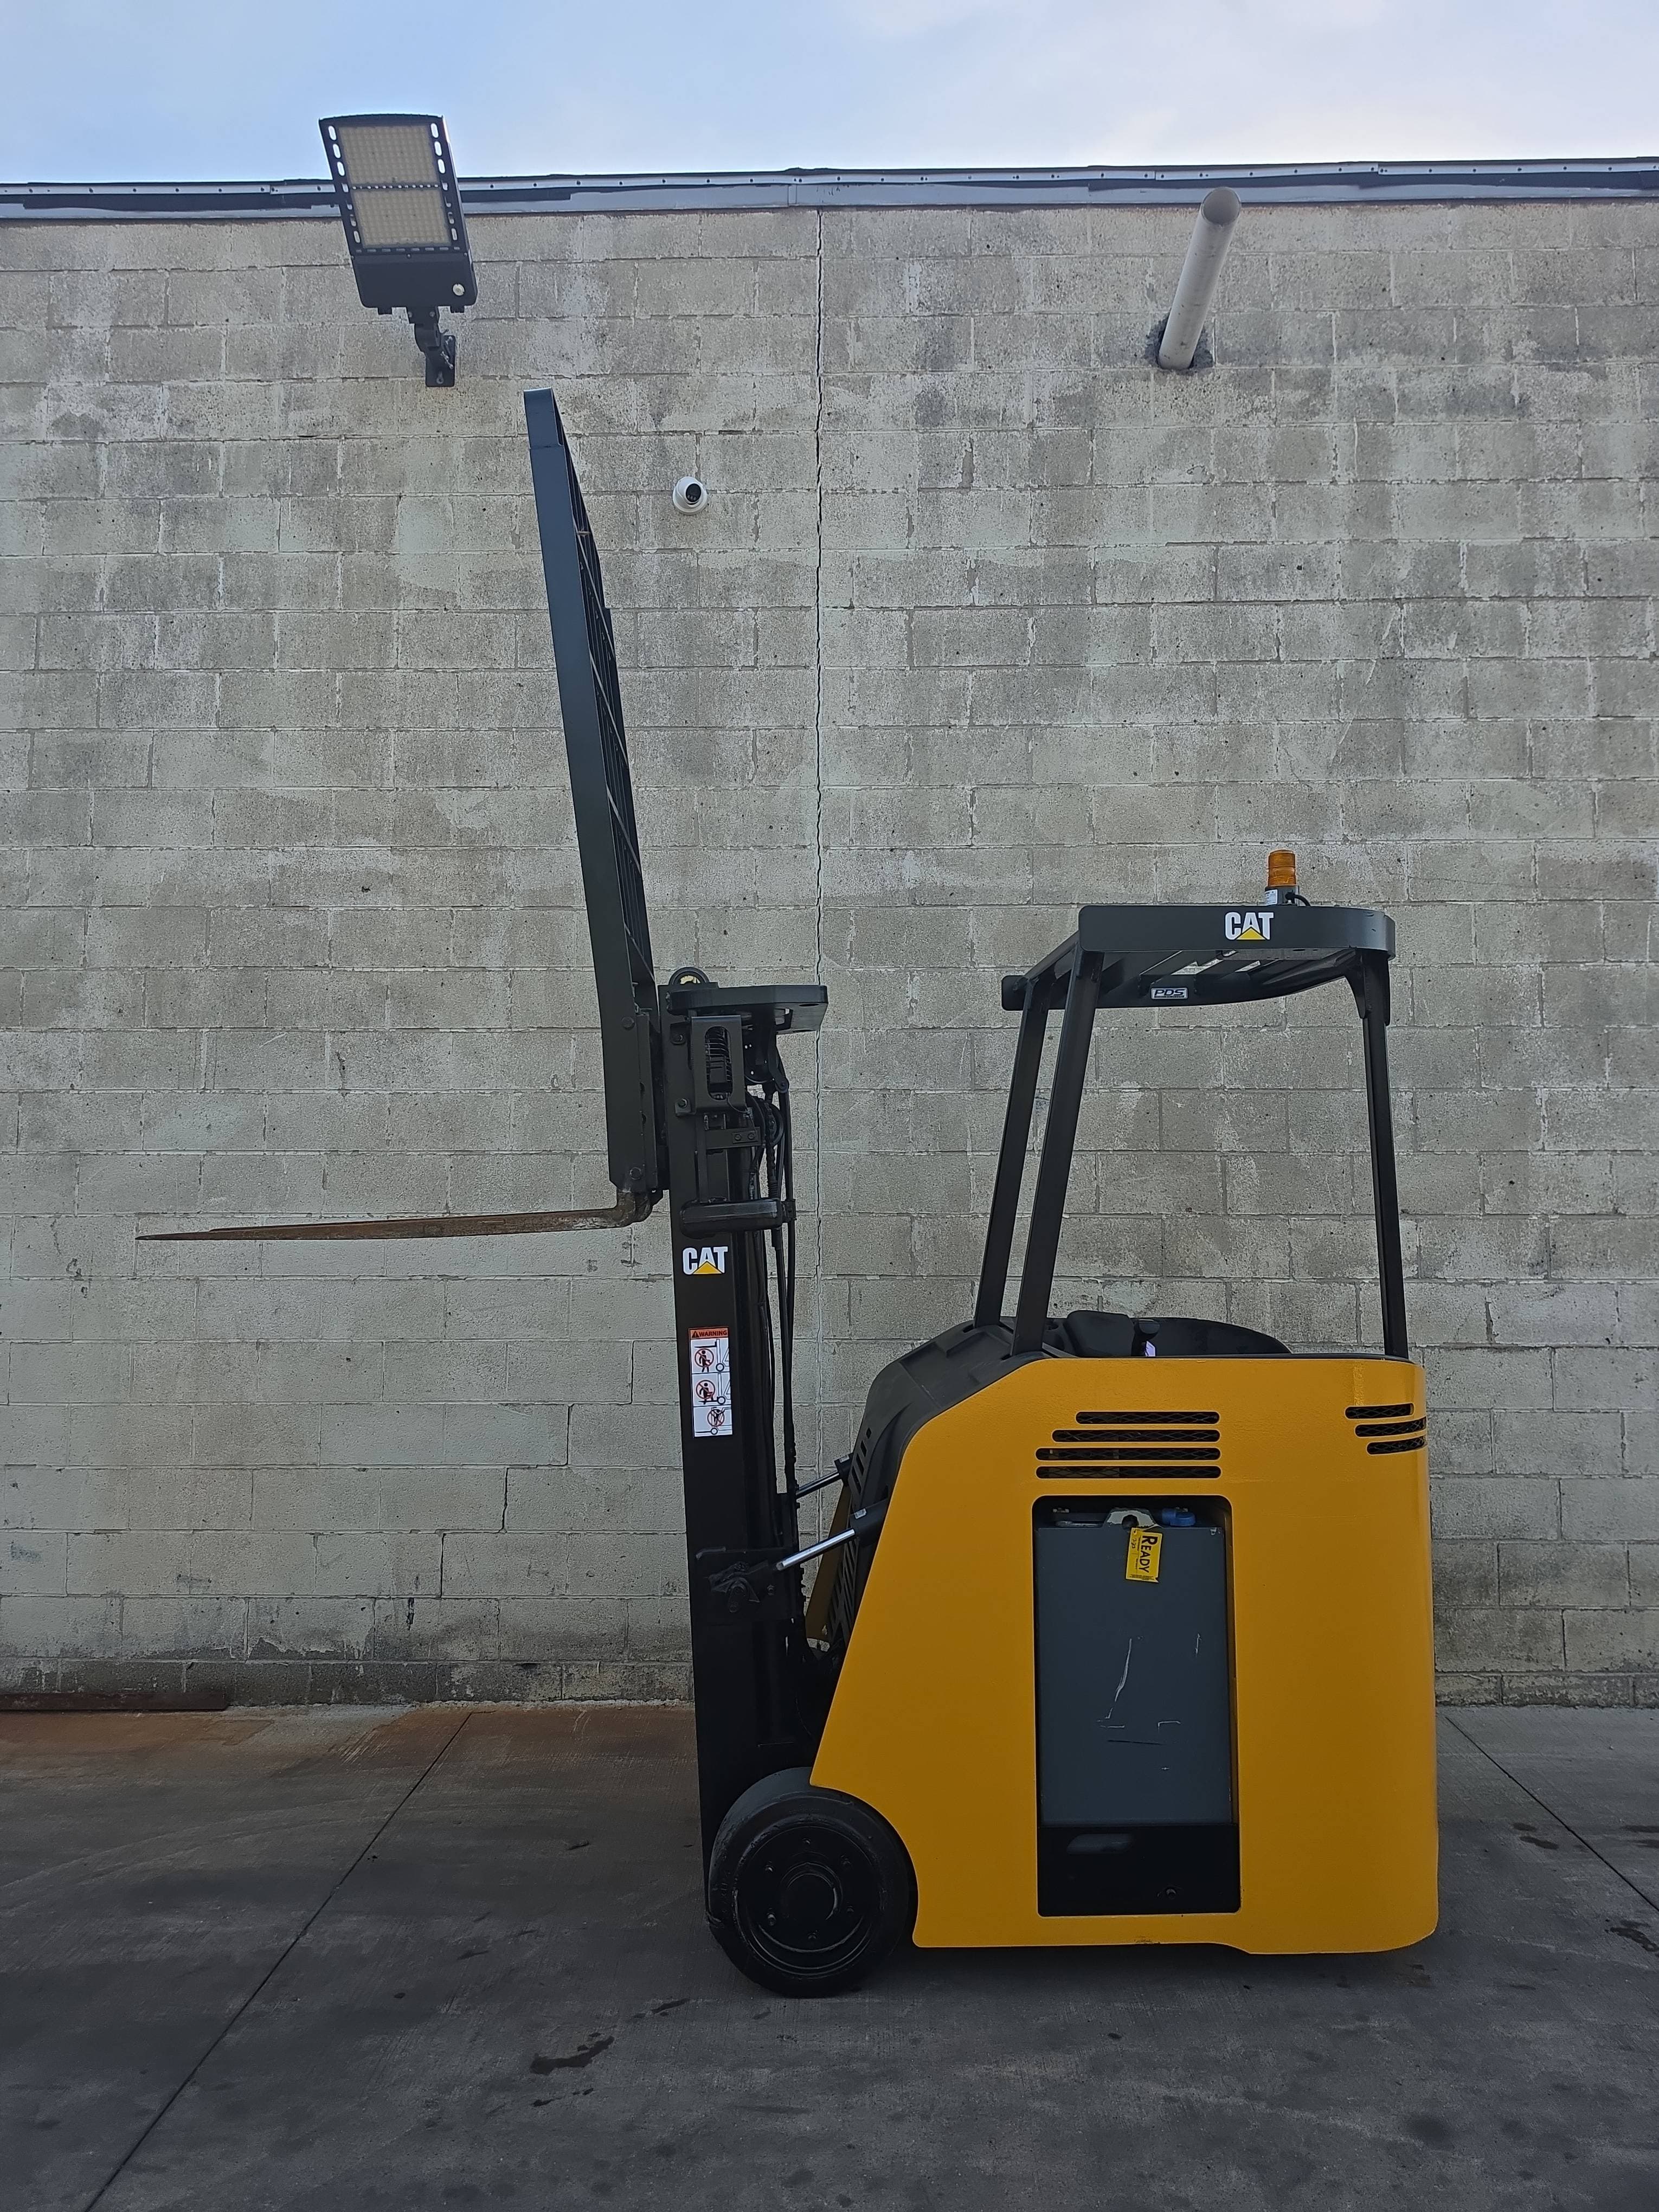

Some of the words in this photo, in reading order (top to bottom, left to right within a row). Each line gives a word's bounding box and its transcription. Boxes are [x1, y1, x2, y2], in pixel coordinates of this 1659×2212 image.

[1225, 911, 1274, 941] CAT
[683, 1246, 728, 1275] CAT
[1139, 1535, 1158, 1573] READY
